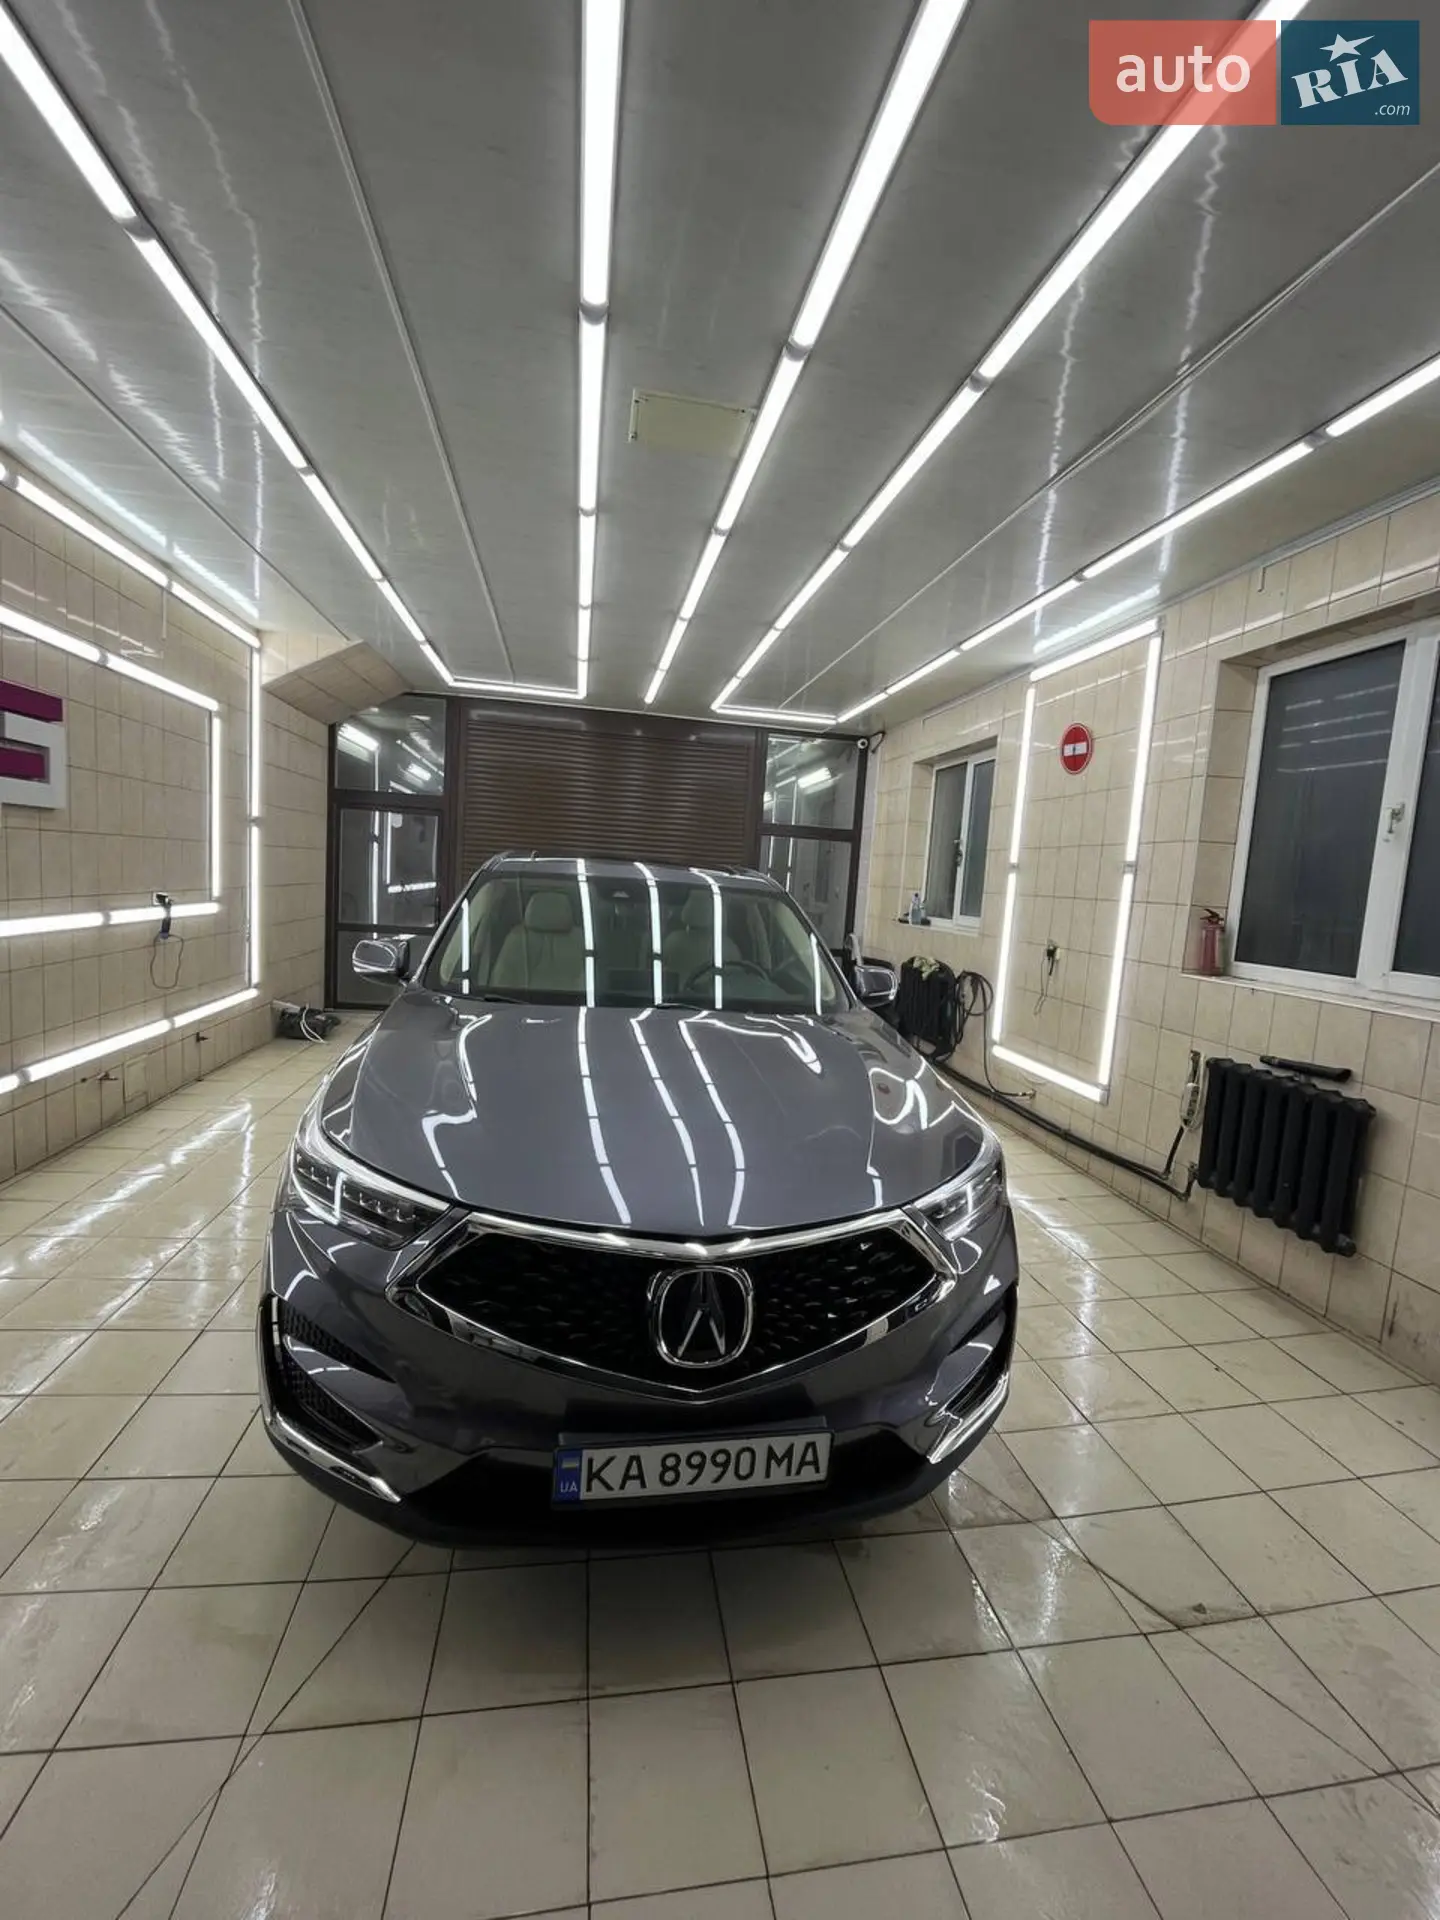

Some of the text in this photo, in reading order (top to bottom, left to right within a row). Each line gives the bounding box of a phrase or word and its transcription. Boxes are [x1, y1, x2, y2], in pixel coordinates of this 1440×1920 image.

[585, 1441, 820, 1492] KA 8990 MA
[560, 1481, 578, 1493] UA
